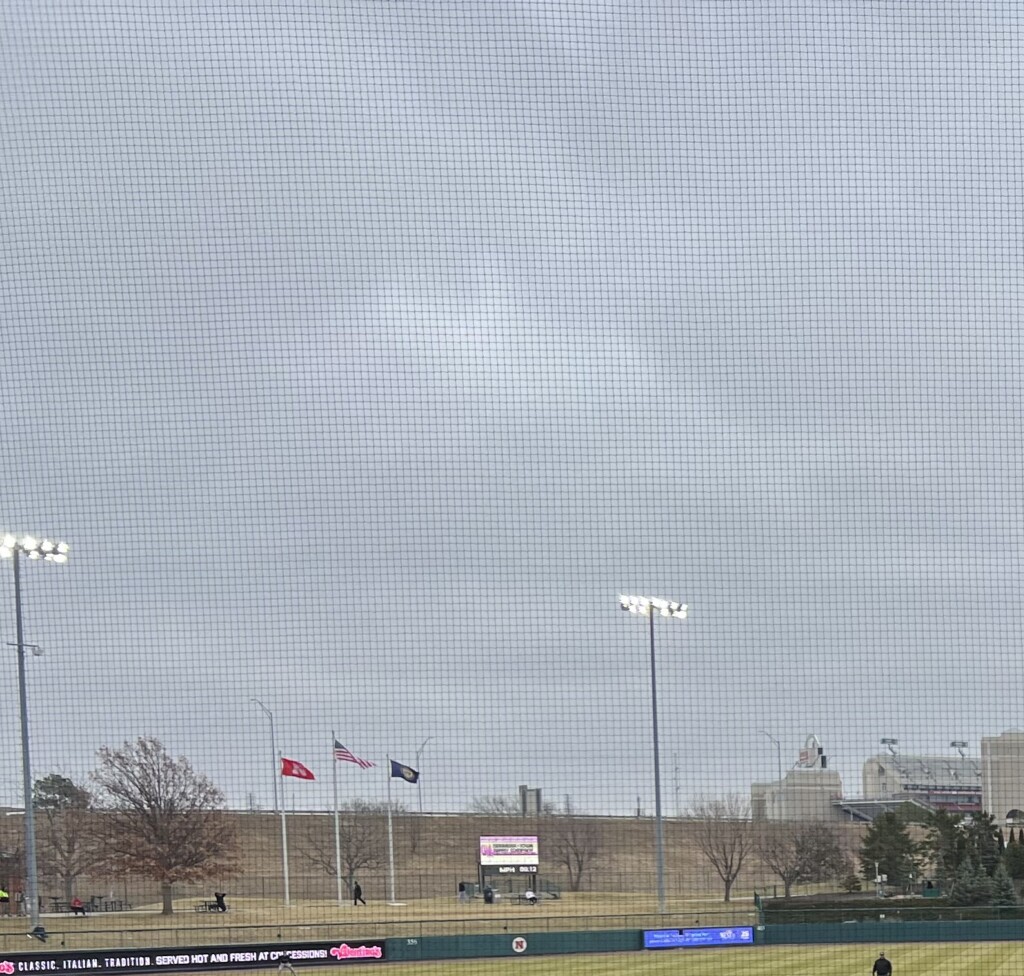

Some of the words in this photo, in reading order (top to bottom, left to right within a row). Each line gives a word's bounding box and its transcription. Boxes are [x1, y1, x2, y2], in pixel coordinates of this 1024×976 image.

[515, 940, 524, 949] N
[18, 960, 60, 972] CLASSIC.
[63, 958, 102, 969] ITALIAN.
[105, 956, 154, 968] TRADITION.
[155, 955, 190, 965] SERVED
[191, 954, 208, 963] HOT
[210, 953, 228, 962] AND
[230, 952, 257, 962] FRESH
[258, 951, 269, 960] AT
